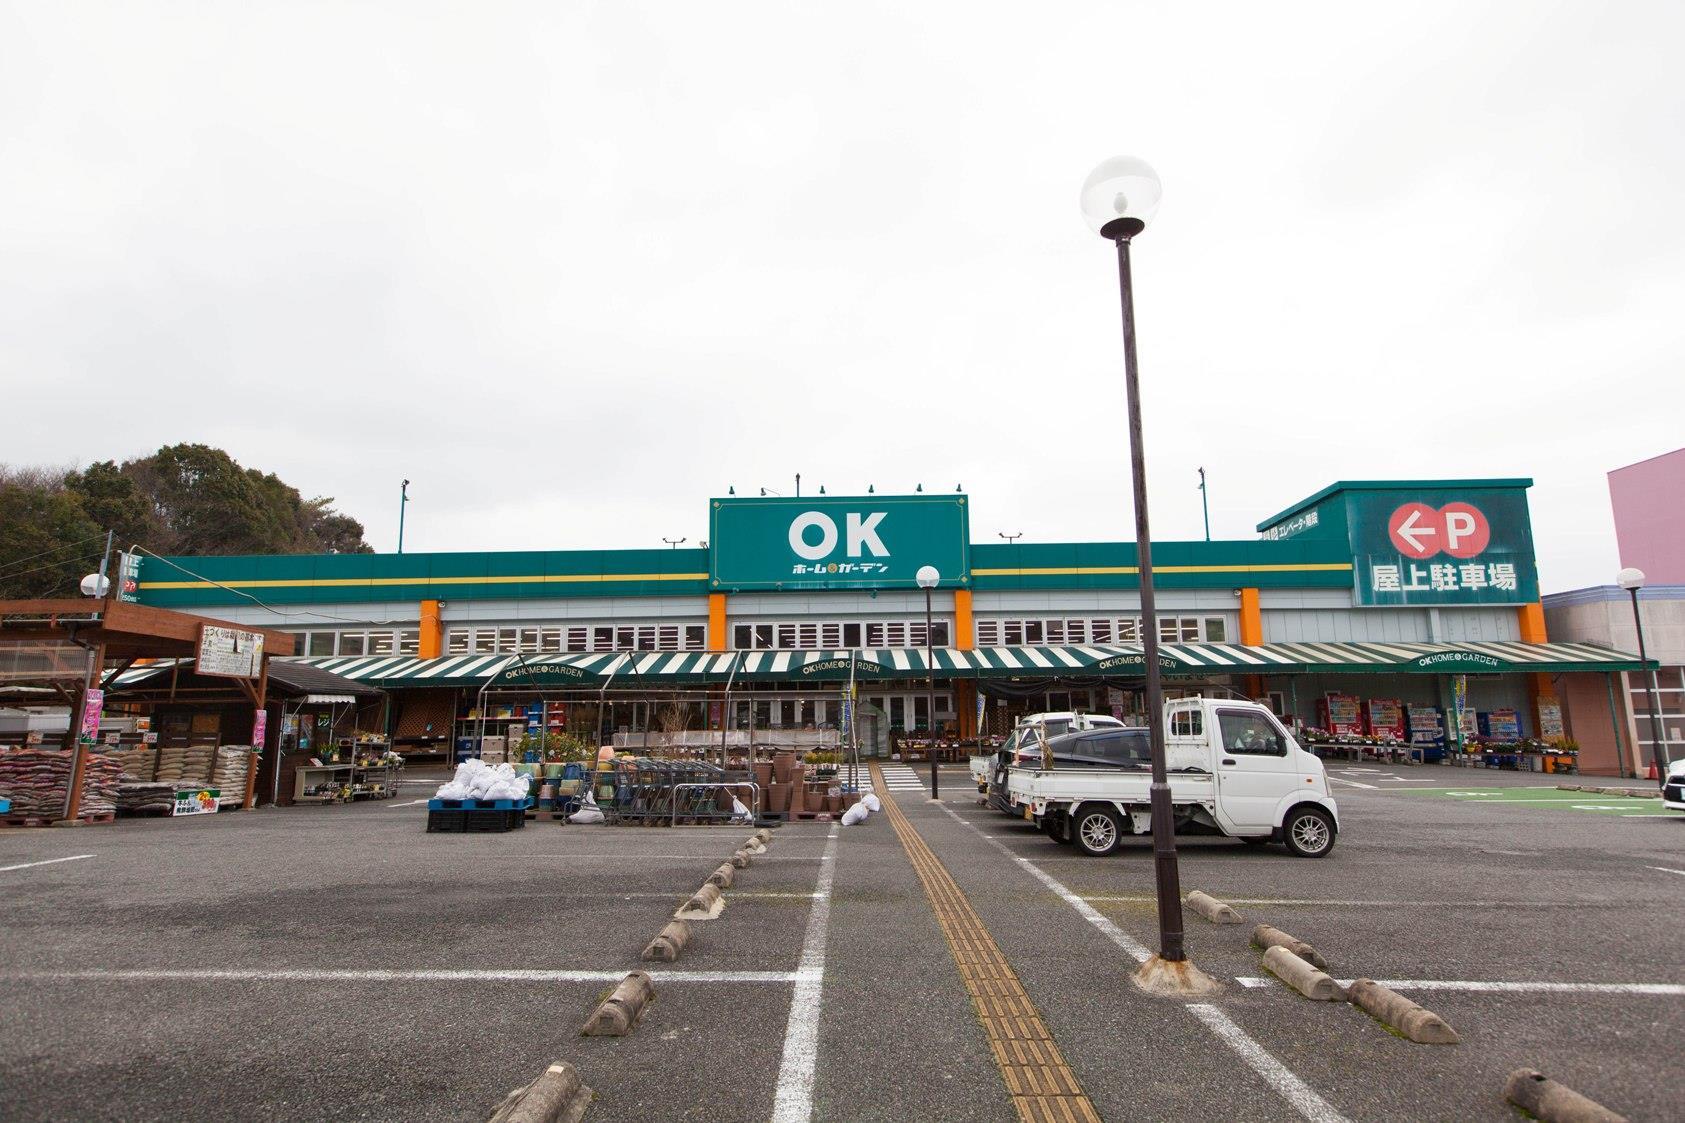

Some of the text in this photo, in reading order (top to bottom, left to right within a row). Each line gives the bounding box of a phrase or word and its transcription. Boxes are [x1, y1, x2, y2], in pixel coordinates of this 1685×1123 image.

[788, 511, 891, 560] OK
[1445, 511, 1476, 549] P
[1372, 563, 1517, 592] 屋上駐車場
[845, 660, 881, 674] GRDEN
[1141, 656, 1177, 669] GDEN
[1461, 653, 1499, 667] GARDEN
[549, 665, 584, 678] GARDEN
